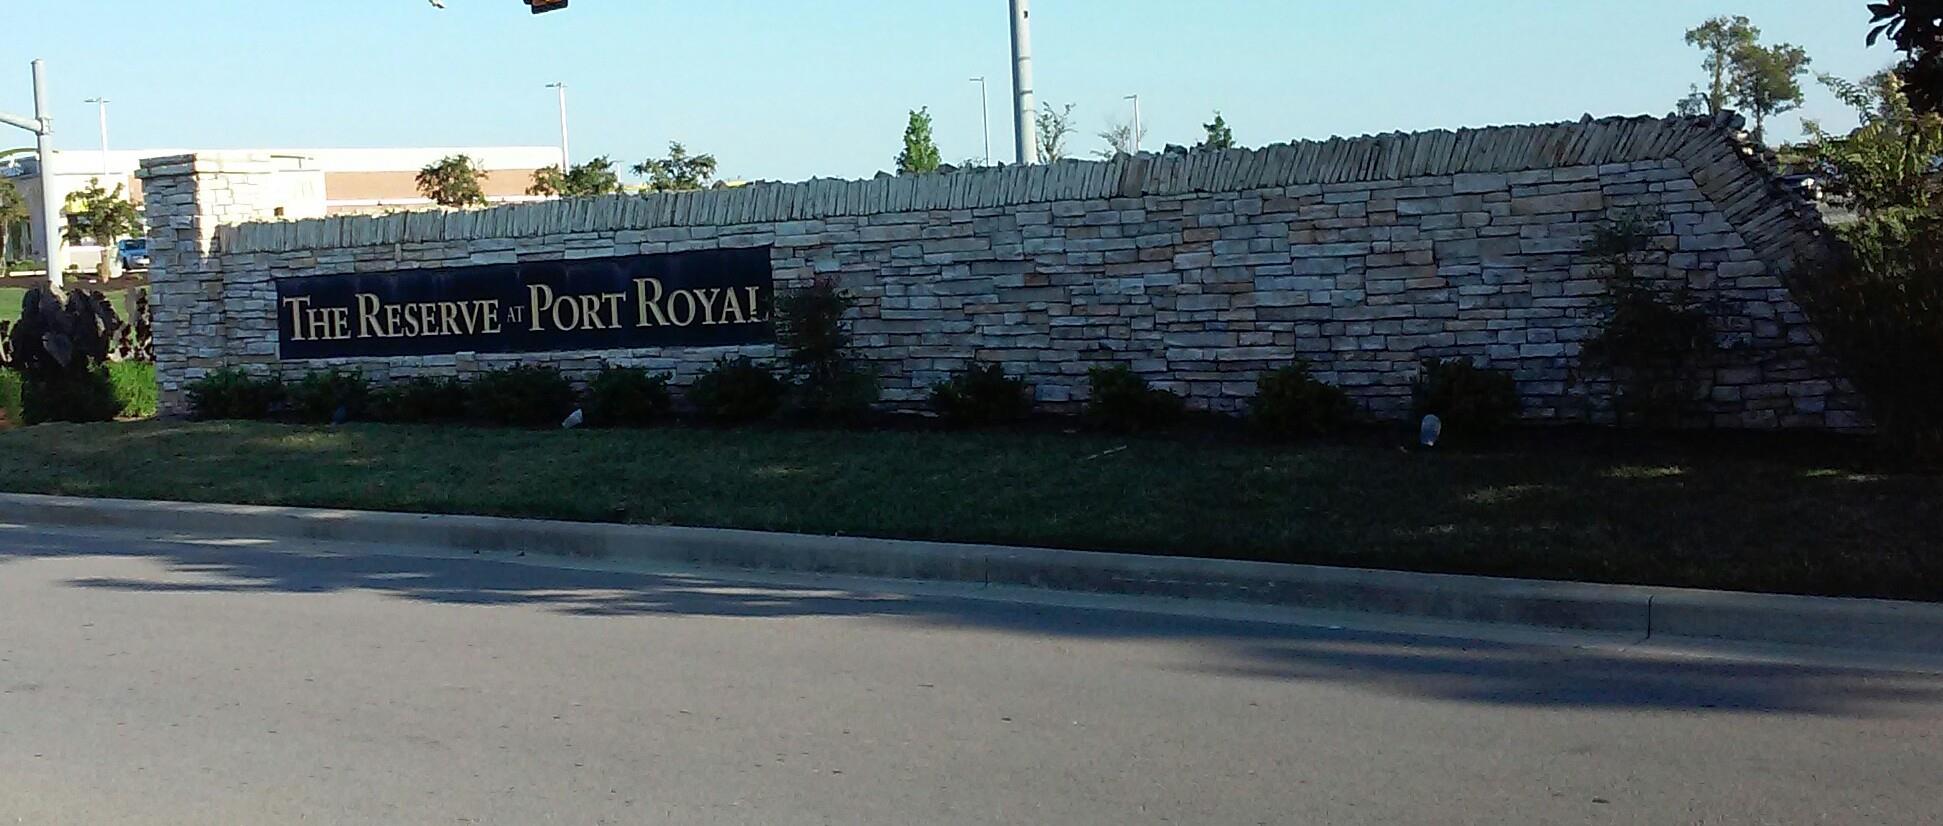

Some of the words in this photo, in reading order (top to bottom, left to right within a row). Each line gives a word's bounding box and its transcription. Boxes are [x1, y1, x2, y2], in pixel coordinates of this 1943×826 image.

[283, 296, 351, 341] THE
[355, 292, 501, 338] RESERVE
[507, 305, 524, 324] AT
[527, 284, 627, 331] PORT
[633, 277, 769, 327] ROYAL
